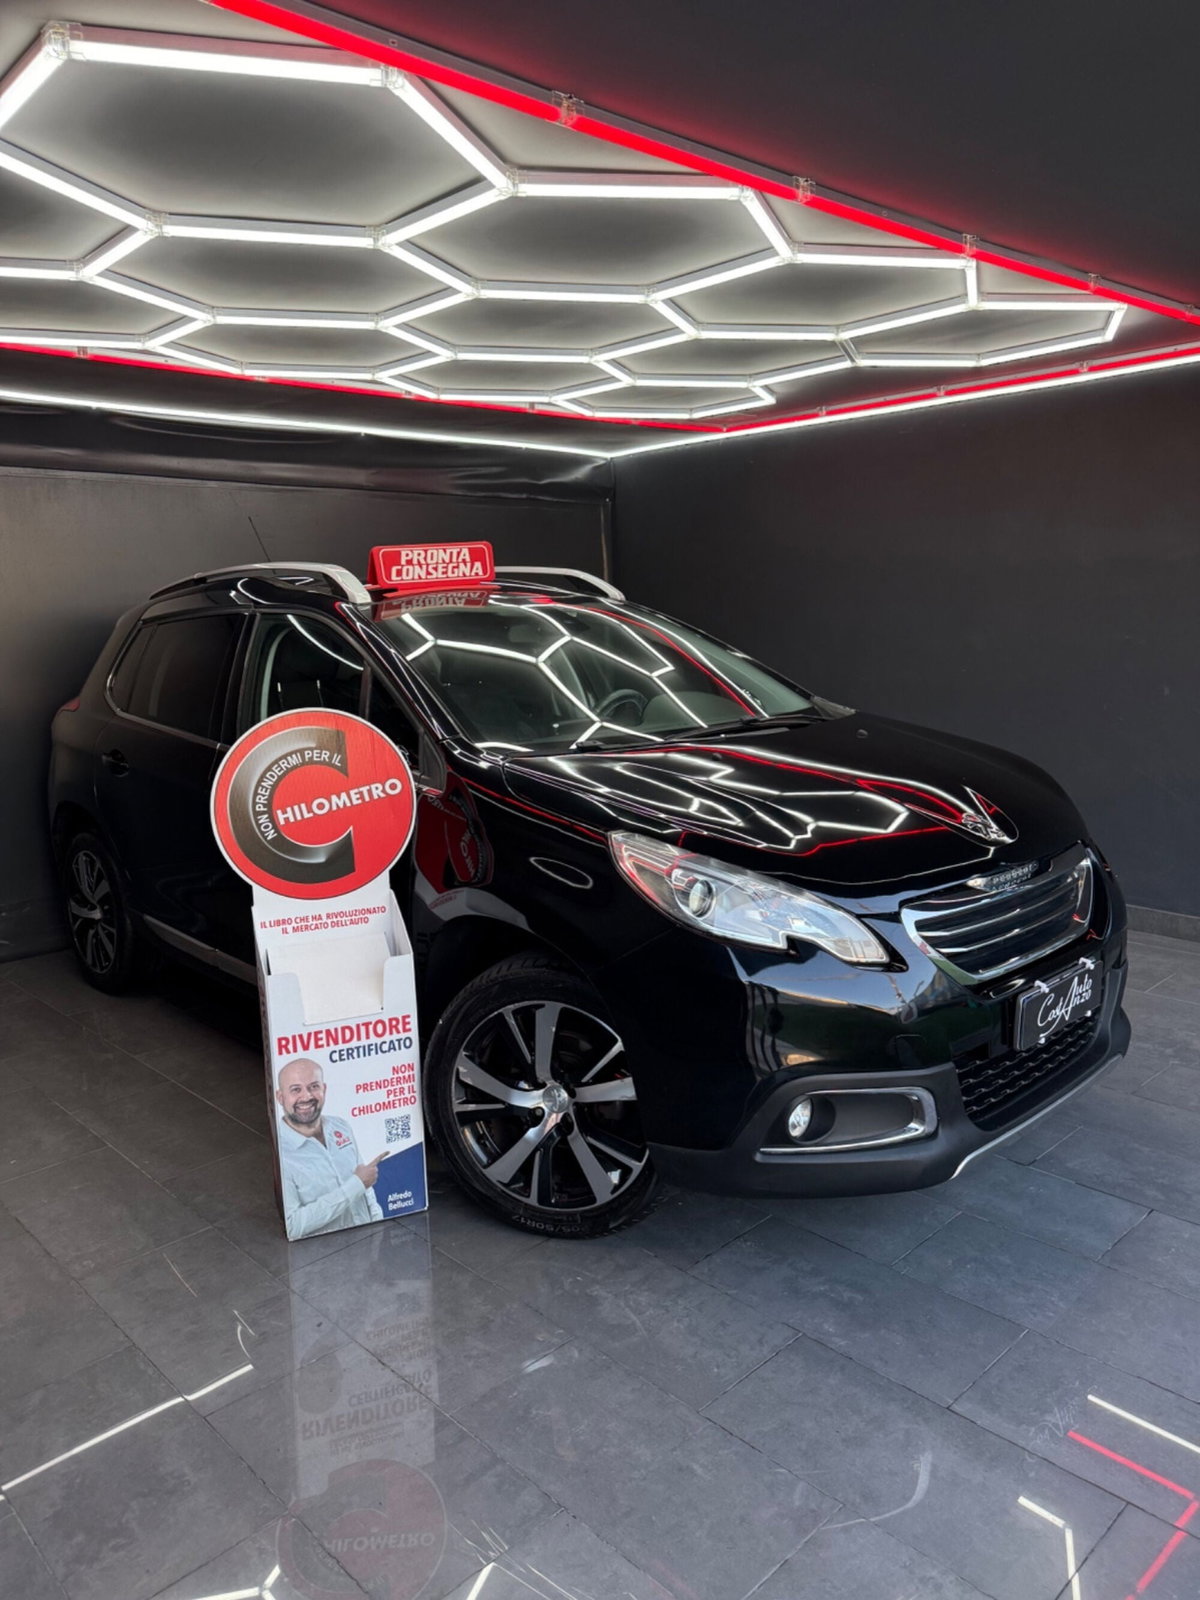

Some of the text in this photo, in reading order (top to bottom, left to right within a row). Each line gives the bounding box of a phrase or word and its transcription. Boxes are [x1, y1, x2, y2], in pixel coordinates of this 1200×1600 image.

[400, 547, 471, 565] PRONTA
[390, 561, 484, 581] CONSEGNA
[256, 750, 343, 841] NON PRENDERMI PER IL
[260, 905, 387, 929] IL LIBRO CHE HA RIVOLUZIONATO
[281, 916, 370, 935] IL MERCATO DELL'AUTO
[277, 1014, 413, 1056] RIVENDITORE
[329, 1036, 413, 1063] CERTIFICATO
[392, 1063, 415, 1076] NON
[355, 1073, 416, 1094] PRENDERMI
[386, 1084, 417, 1099] PER IL
[351, 1095, 417, 1118] CHILOMETRO
[387, 1190, 413, 1202] Alfredo
[388, 1198, 415, 1211] Bellucci
